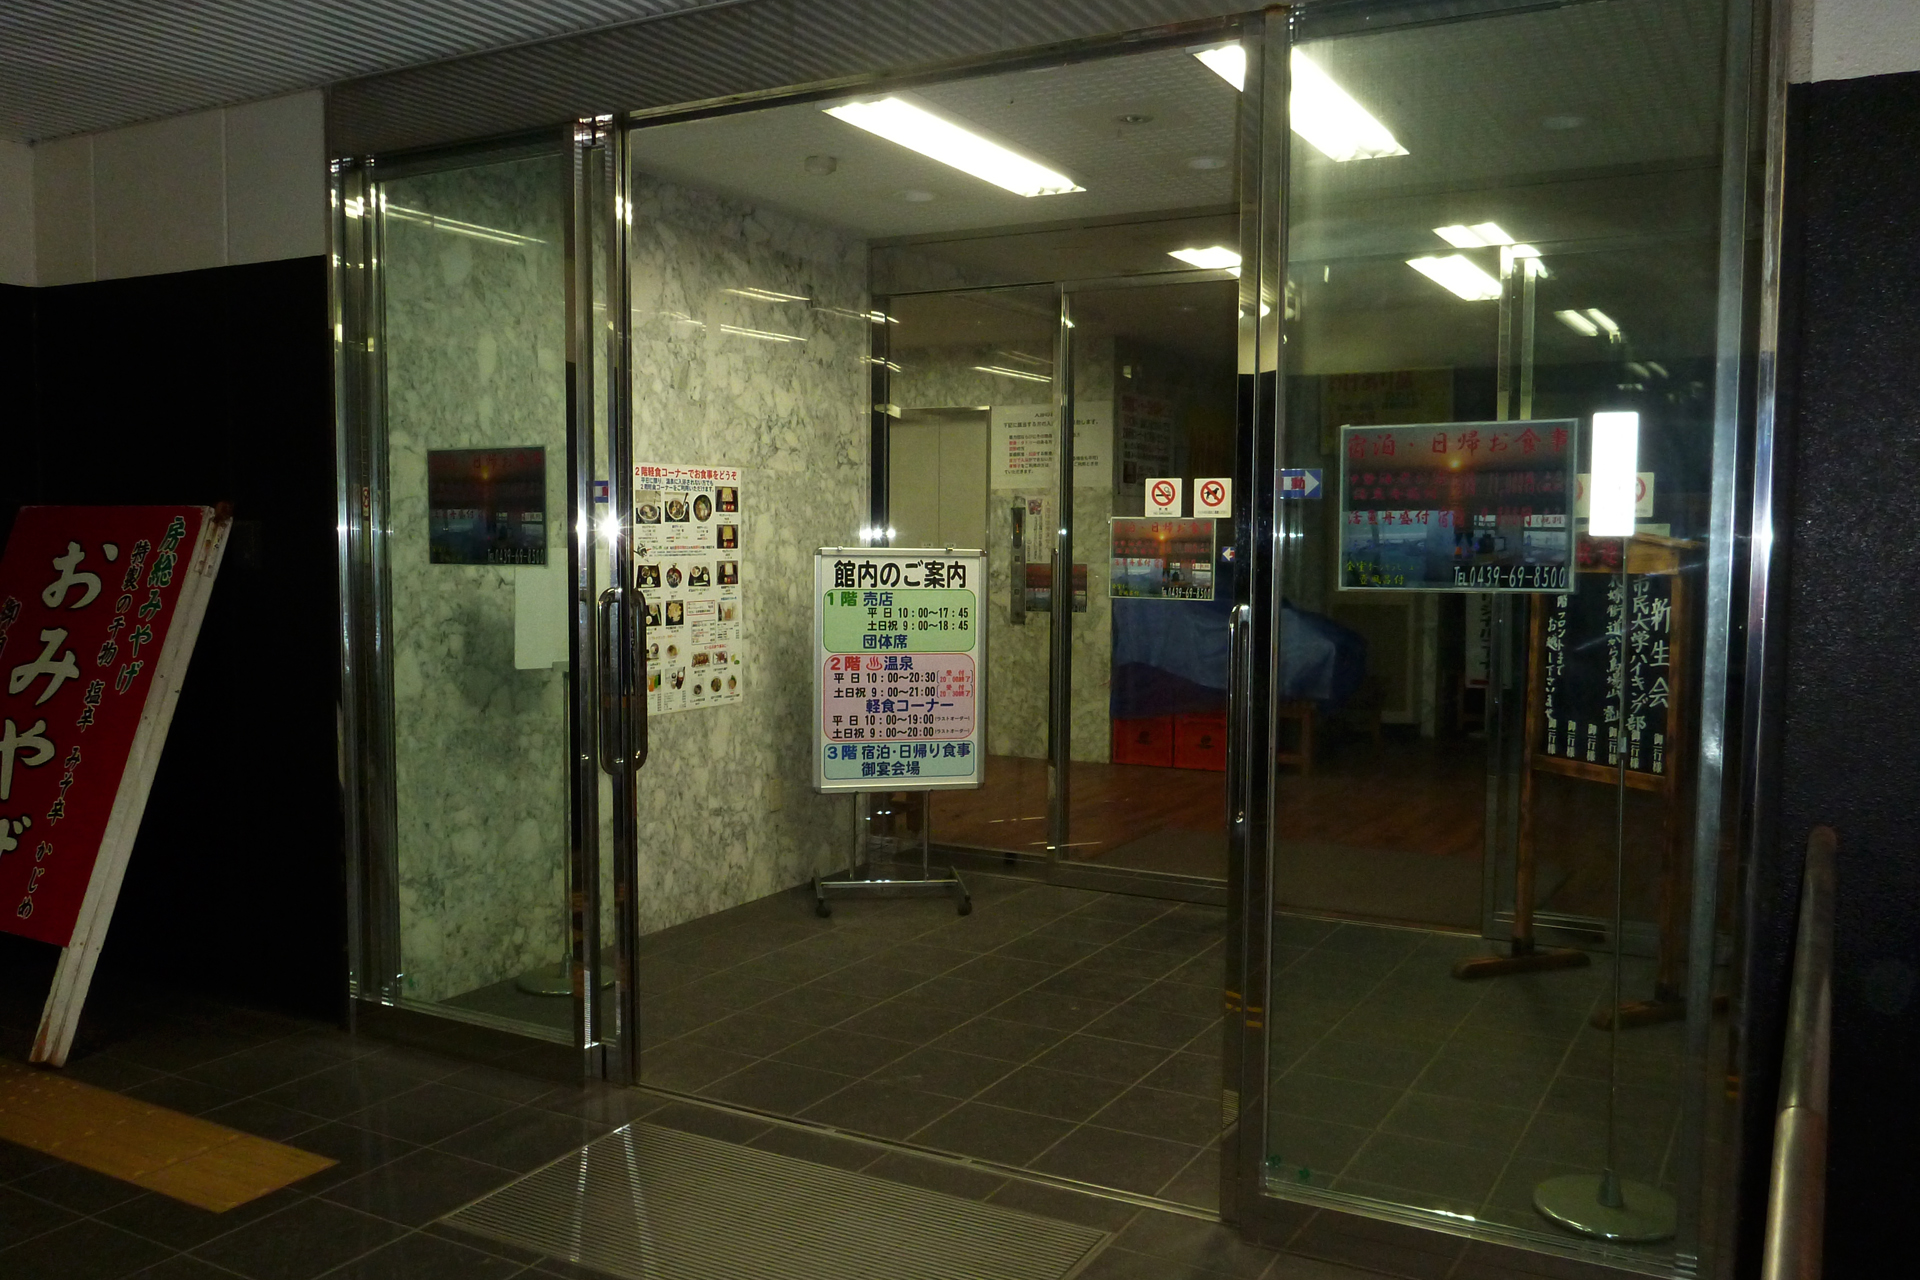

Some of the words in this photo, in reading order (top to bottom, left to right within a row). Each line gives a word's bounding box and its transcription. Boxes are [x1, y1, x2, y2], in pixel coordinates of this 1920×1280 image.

[635, 466, 737, 481] 2階軽食コーナーでお食事をどうぞ
[834, 559, 967, 588] 館内のご案内
[97, 539, 151, 668] 特製の干物
[114, 514, 187, 696] 房総みやげ
[863, 591, 894, 607] 売店
[867, 620, 898, 631] 土日祝
[863, 634, 908, 650] 団体席
[1648, 597, 1672, 709] 新生会
[883, 655, 914, 671] 温泉
[833, 687, 867, 699] 土日祝
[76, 679, 106, 734] 塩辛
[866, 698, 954, 714] 軽食コーナー
[832, 728, 865, 740] 土日祝
[862, 743, 971, 760] 宿泊・日帰り食事
[861, 760, 921, 777] 御宴会場
[16, 840, 54, 920] かじめ
